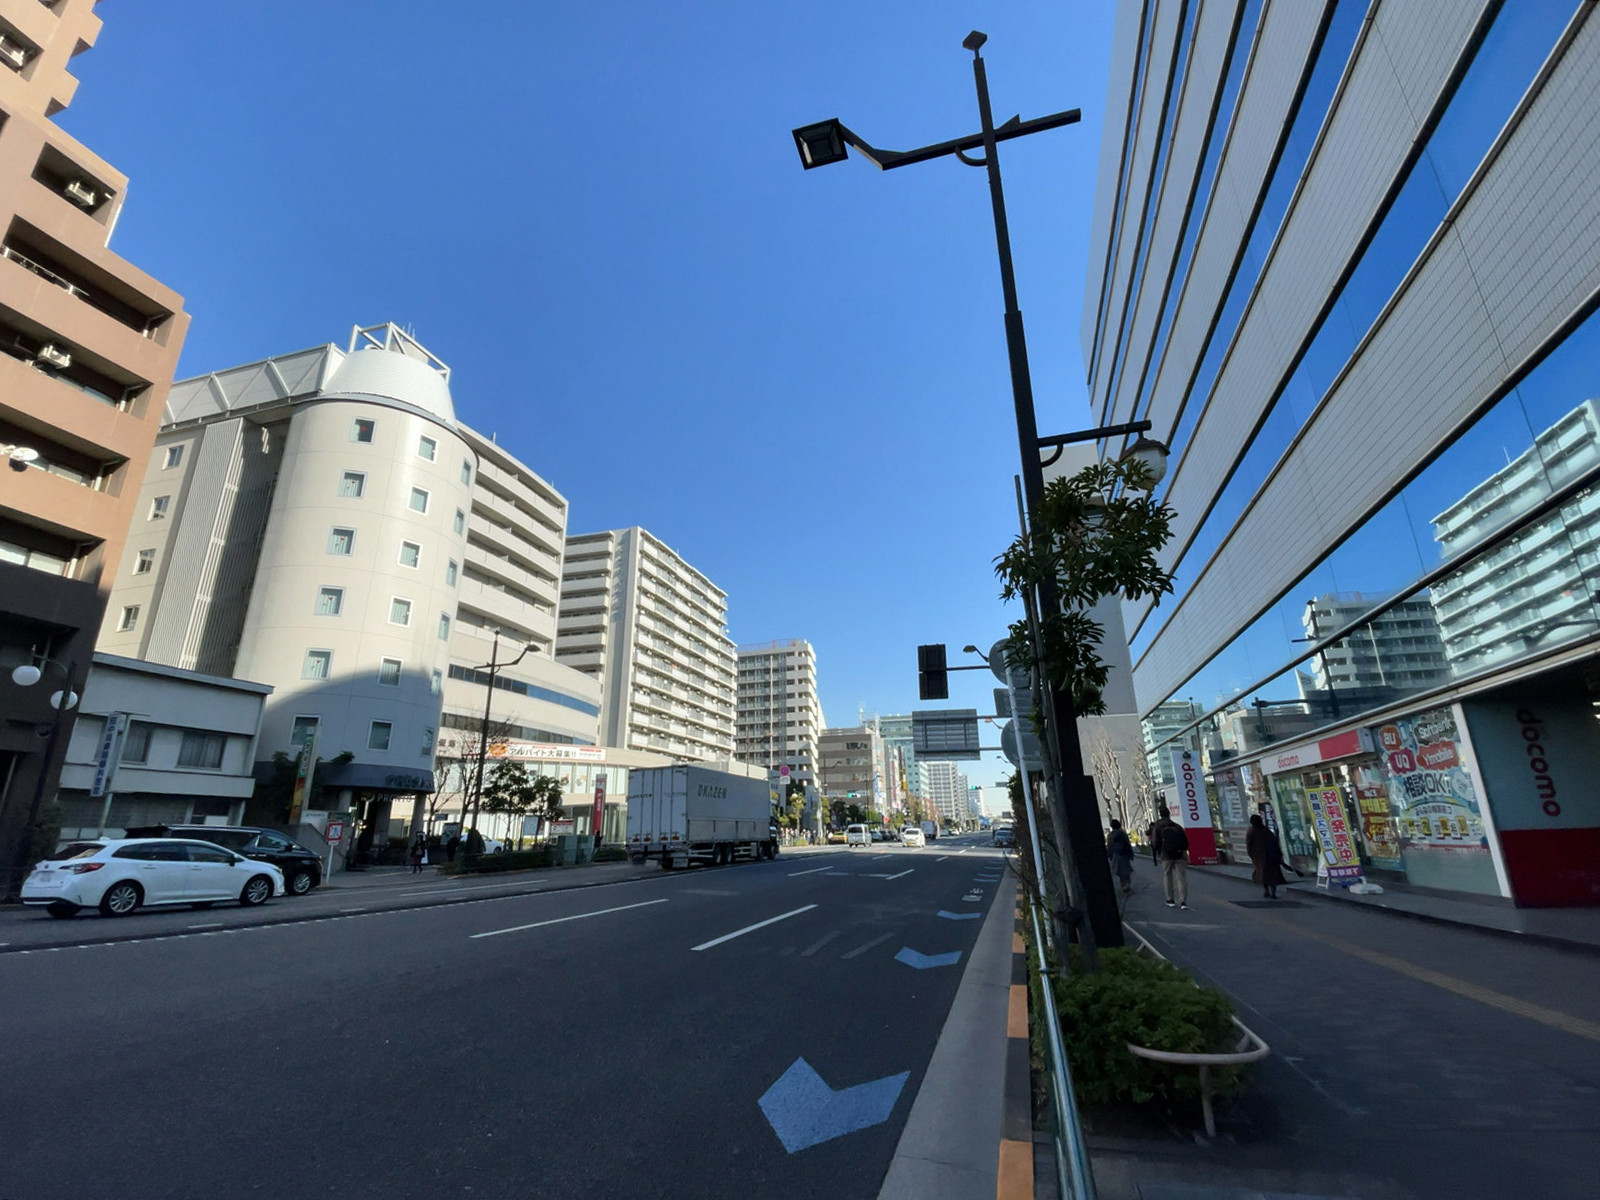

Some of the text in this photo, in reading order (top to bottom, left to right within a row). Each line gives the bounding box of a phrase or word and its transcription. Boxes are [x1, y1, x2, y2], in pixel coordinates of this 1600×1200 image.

[1383, 732, 1397, 745] au
[1277, 754, 1300, 769] docomo
[1394, 754, 1411, 769] UQ
[1516, 708, 1561, 818] docomo
[1181, 762, 1200, 821] docomo
